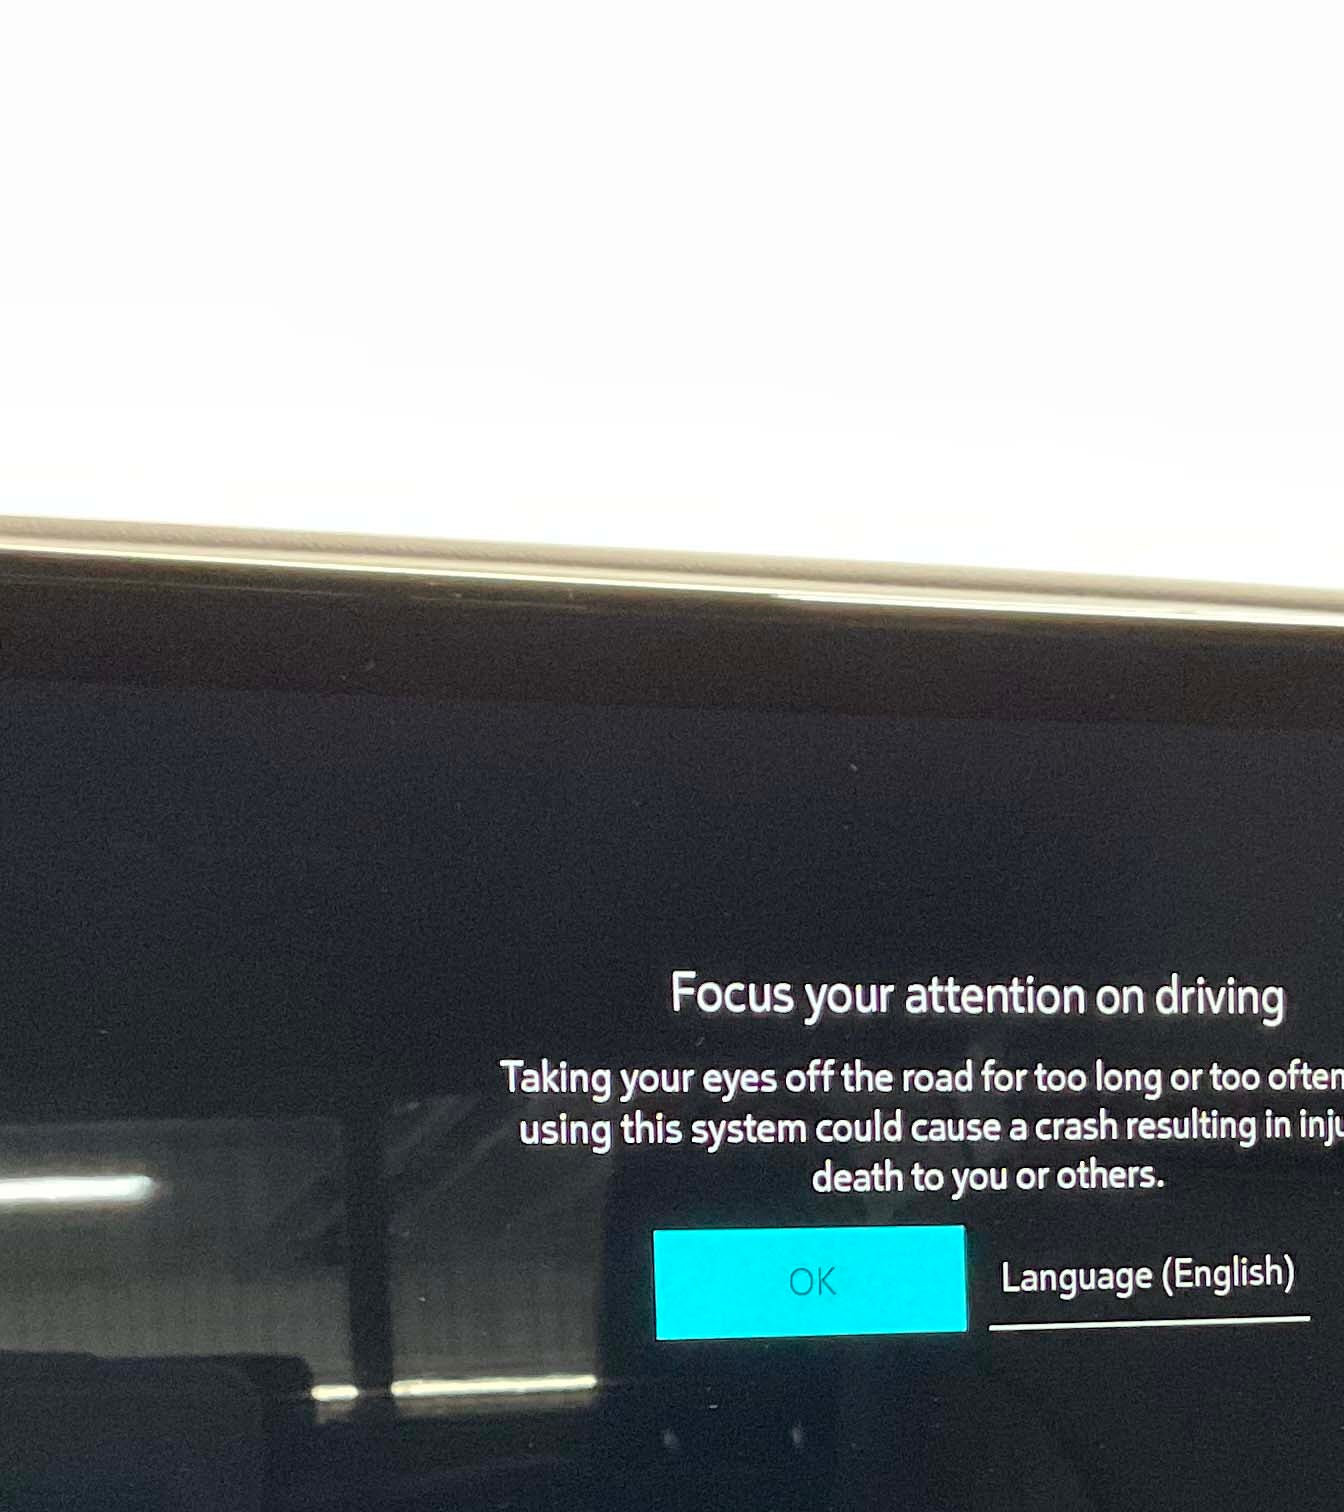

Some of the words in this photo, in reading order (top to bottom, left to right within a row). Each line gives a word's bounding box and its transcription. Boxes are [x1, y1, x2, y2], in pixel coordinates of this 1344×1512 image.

[672, 970, 795, 1014] Focus
[804, 983, 895, 1026] your
[905, 975, 1085, 1015] attention
[1096, 985, 1145, 1015] on
[1155, 972, 1286, 1028] driving
[499, 1057, 611, 1103] Taking
[619, 1069, 694, 1103] your
[702, 1069, 778, 1103] eyes
[785, 1058, 836, 1093] off
[840, 1058, 894, 1093] the
[903, 1058, 973, 1093] road
[980, 1058, 1028, 1092] for
[1033, 1062, 1087, 1092] too
[1095, 1058, 1163, 1101] long
[1170, 1068, 1204, 1091] or
[1209, 1062, 1261, 1091] too
[520, 1112, 611, 1154] using
[620, 1109, 683, 1144] this
[691, 1113, 807, 1153] system
[815, 1108, 903, 1143] could
[911, 1118, 1002, 1142] cause
[1009, 1118, 1028, 1141] a
[1035, 1107, 1118, 1141] crash
[1126, 1106, 1257, 1148] resulting
[1265, 1107, 1292, 1139] in
[812, 1158, 904, 1193] death
[910, 1162, 945, 1192] to
[951, 1167, 1008, 1201] you
[1016, 1167, 1050, 1190] or
[1056, 1156, 1165, 1190] others.
[789, 1266, 837, 1296] OK
[1002, 1261, 1153, 1301] Language
[1162, 1253, 1295, 1297] (English)
